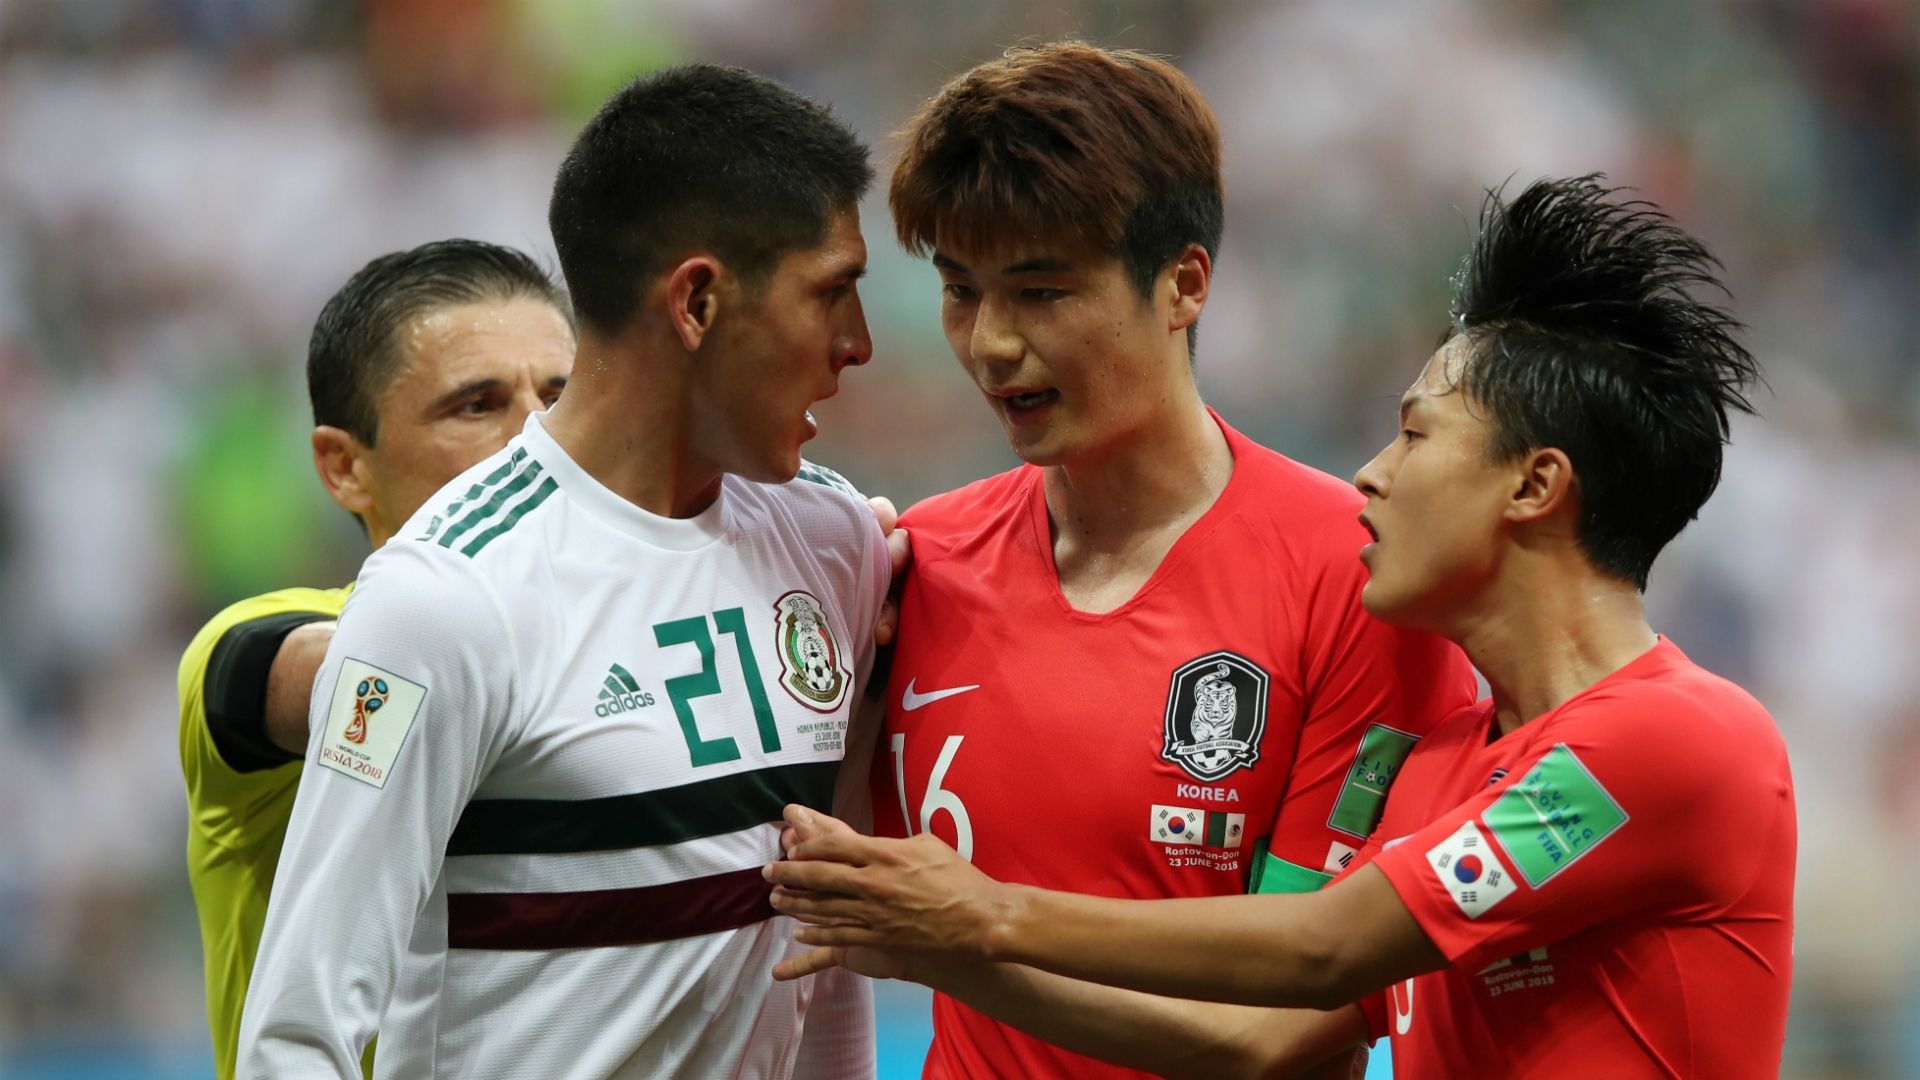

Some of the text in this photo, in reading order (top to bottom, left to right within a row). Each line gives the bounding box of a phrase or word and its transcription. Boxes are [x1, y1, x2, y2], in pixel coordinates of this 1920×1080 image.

[652, 606, 782, 769] 21
[595, 692, 655, 718] adidas
[353, 760, 382, 779] 2018
[890, 733, 974, 864] 16
[1176, 783, 1240, 802] KOREA
[1534, 771, 1595, 840] LIVING
[1165, 846, 1240, 860] Rostov-on-Don
[1536, 831, 1563, 864] FIFA
[1168, 857, 1239, 872] 23 JUNE 2018
[1489, 975, 1555, 997] 23 JUNE 2018
